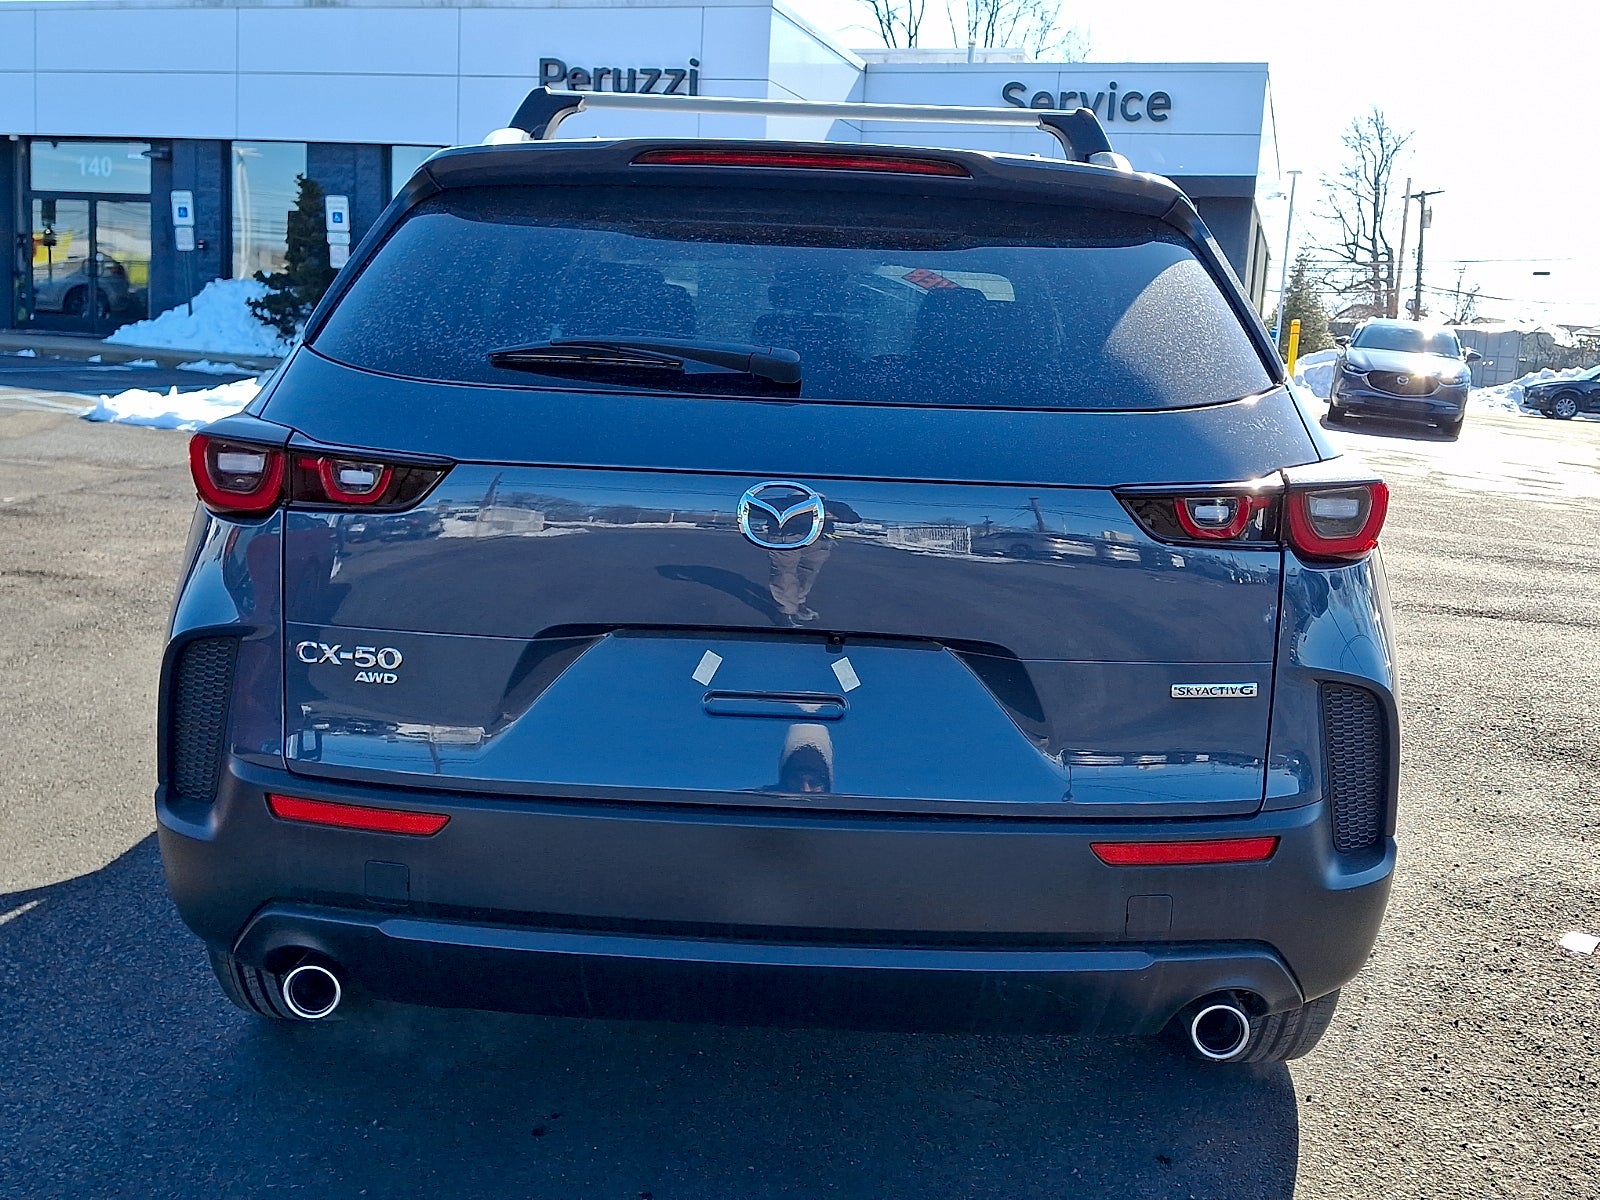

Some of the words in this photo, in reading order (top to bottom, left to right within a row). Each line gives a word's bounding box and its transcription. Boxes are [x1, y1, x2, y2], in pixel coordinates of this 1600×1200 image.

[539, 57, 699, 96] Peruzzi
[1002, 81, 1172, 122] Service
[79, 155, 112, 177] 140
[296, 640, 403, 670] CX-50
[354, 671, 398, 685] AWD
